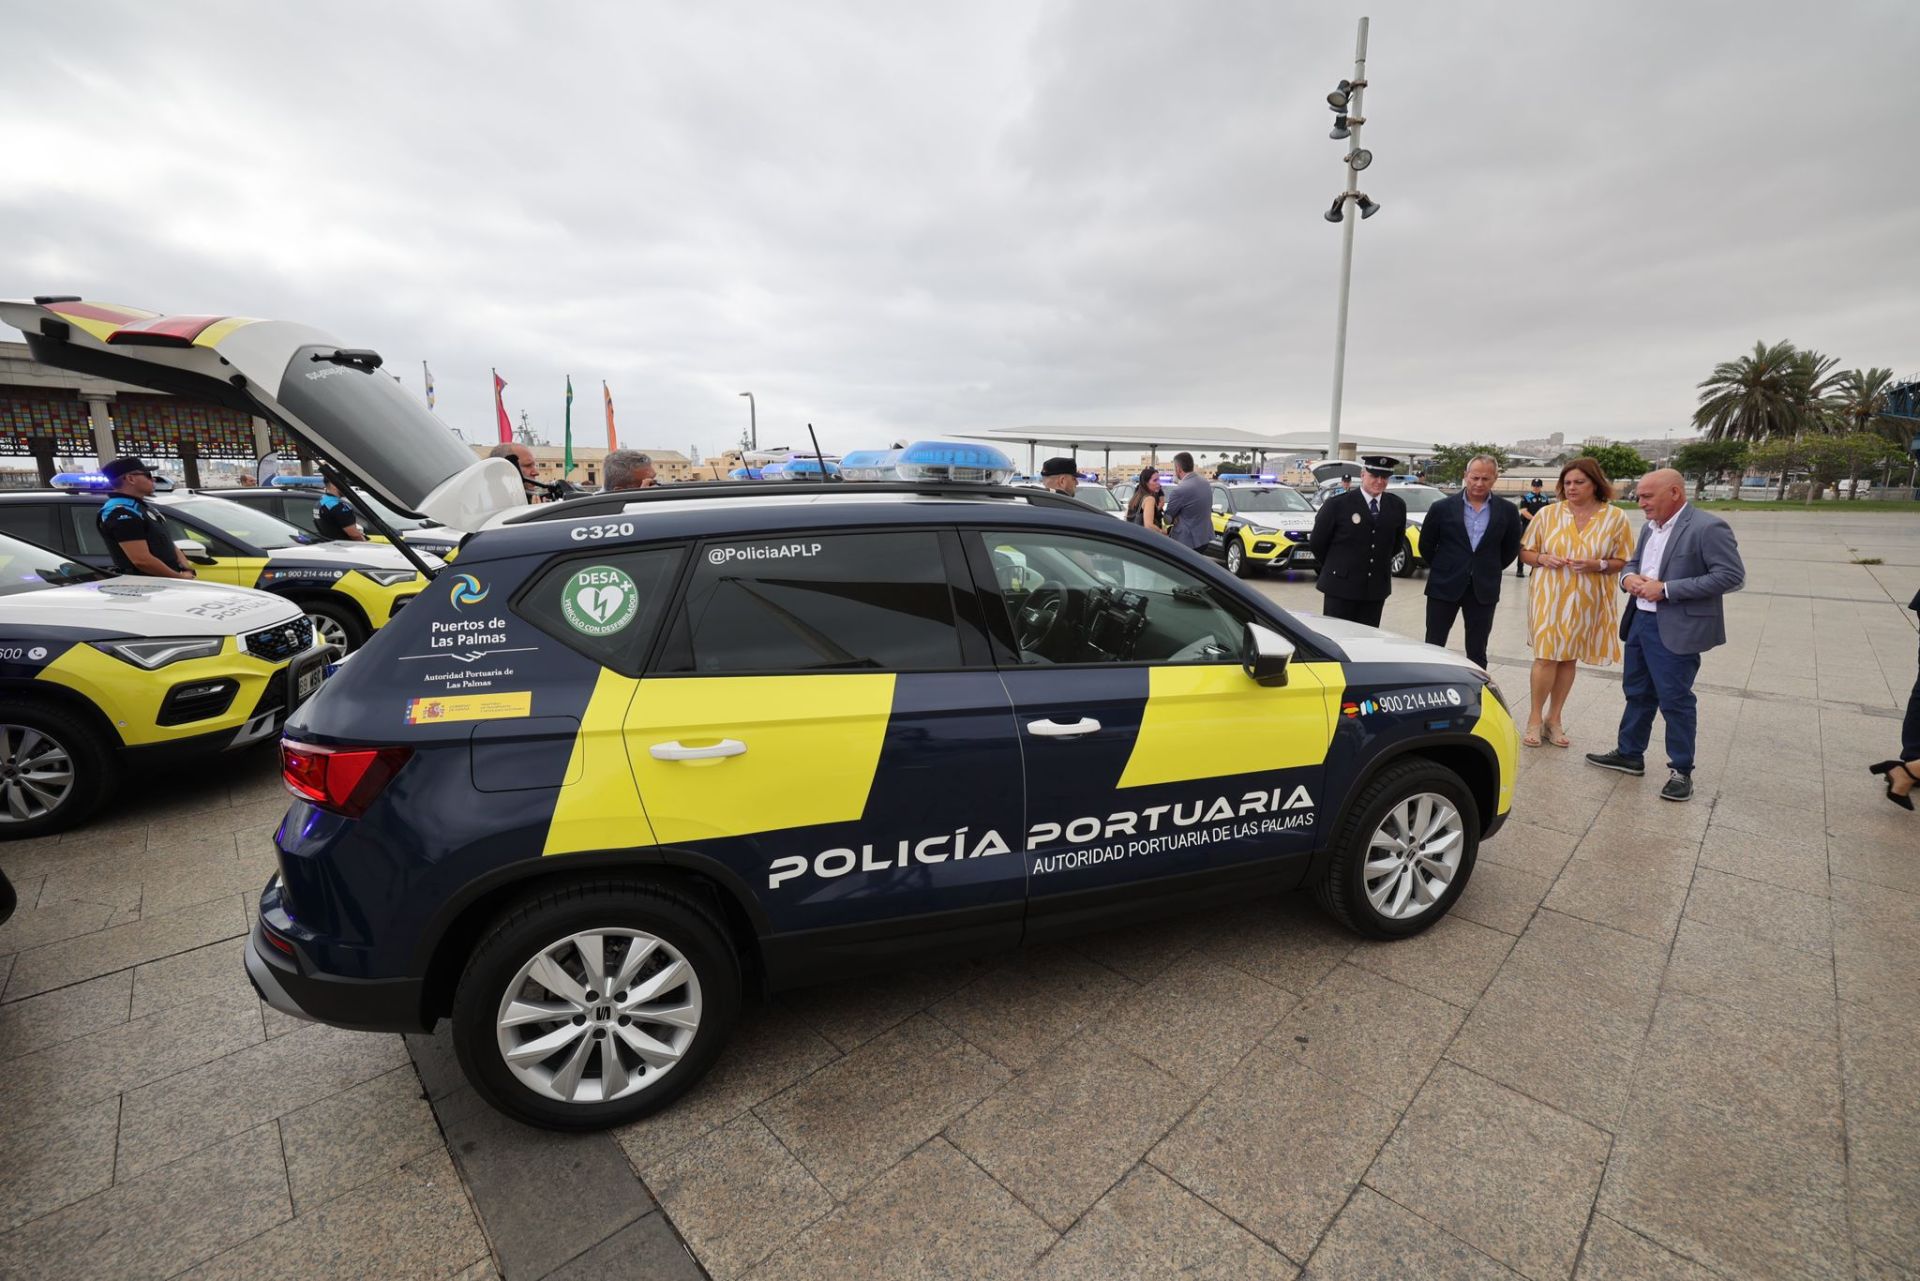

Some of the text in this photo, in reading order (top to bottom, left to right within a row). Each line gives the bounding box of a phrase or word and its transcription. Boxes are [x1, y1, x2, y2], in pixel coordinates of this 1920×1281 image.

[570, 522, 635, 541] C320
[708, 543, 822, 565] @PoliciaAPLP
[288, 570, 332, 578] 900 214 444
[578, 571, 620, 586] DESA
[584, 624, 600, 632] CON
[601, 593, 637, 633] DESFIBRILADOR
[431, 616, 506, 633] Puertos de
[431, 632, 507, 648] Las Palmas
[424, 667, 514, 682] Autoridad Portuaria de
[446, 680, 492, 689] Las Palmas
[1379, 690, 1447, 713] 900 214 444
[768, 784, 1315, 890] POLICÍA PORTUARIA
[1033, 812, 1315, 875] AUTORIDAD PORTUARIA DE LAS PALMAS
